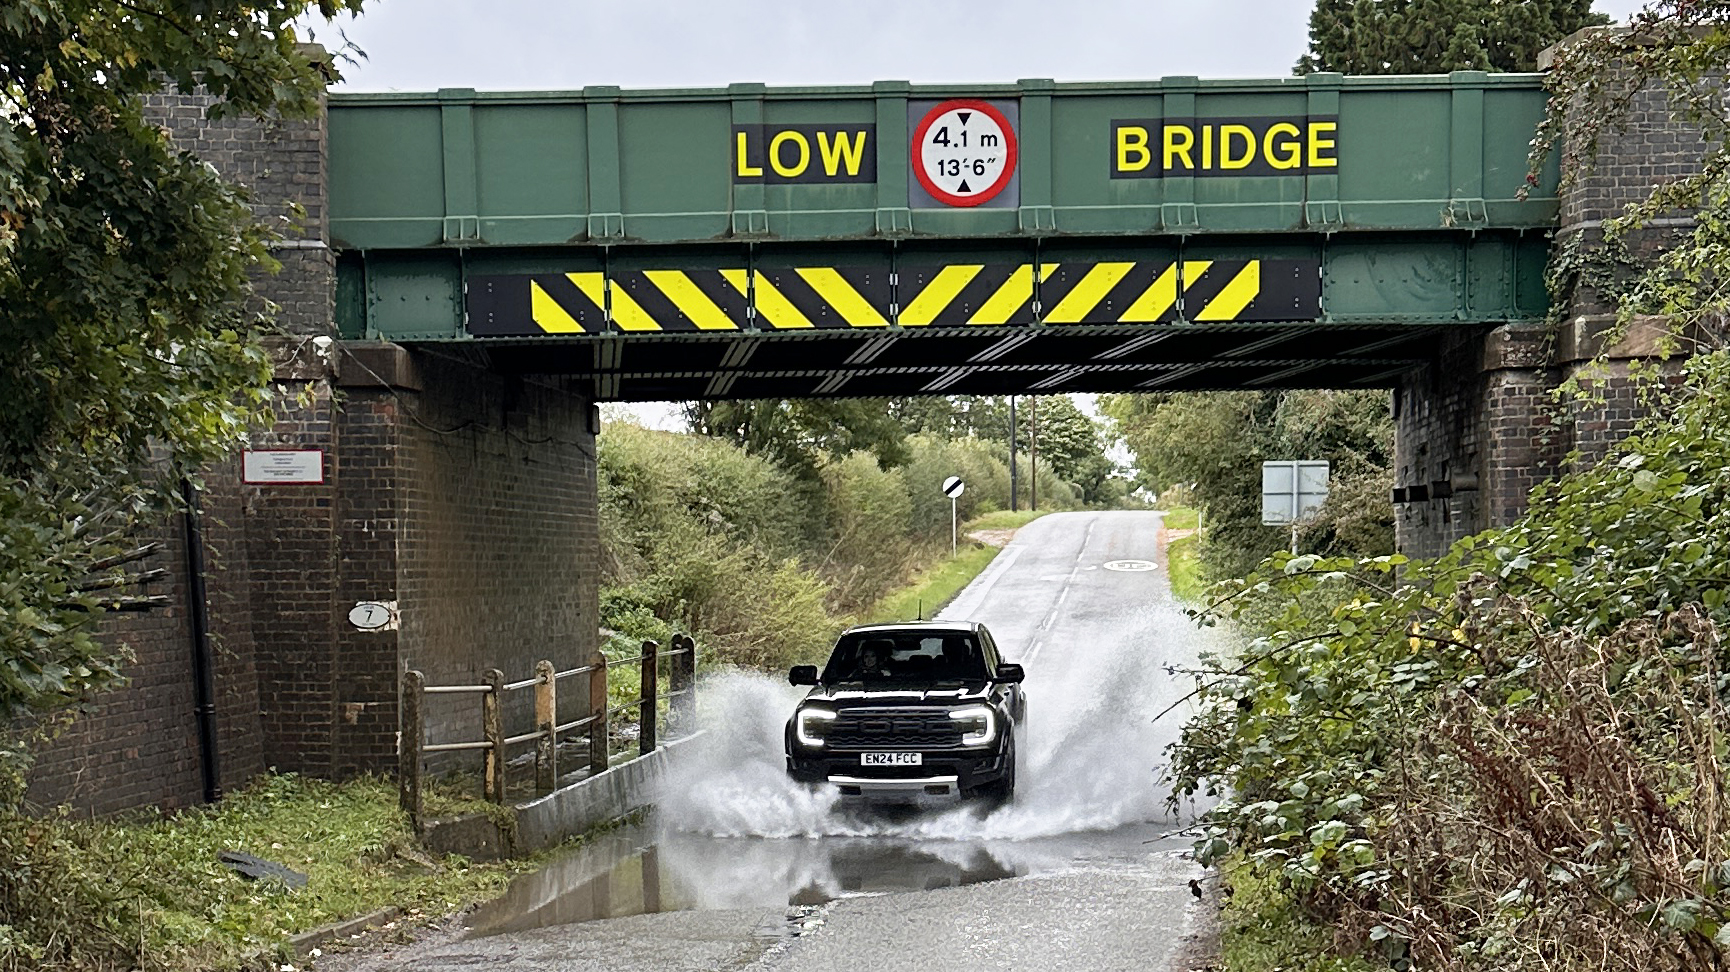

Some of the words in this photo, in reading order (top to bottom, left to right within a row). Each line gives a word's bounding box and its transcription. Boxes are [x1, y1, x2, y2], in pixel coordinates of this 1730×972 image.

[932, 126, 968, 148] 4.1
[980, 134, 998, 147] m
[1116, 122, 1338, 172] BRIDGE
[737, 130, 867, 177] LOW
[364, 610, 374, 622] 7
[865, 753, 894, 764] EN24
[896, 753, 918, 764] FCC
